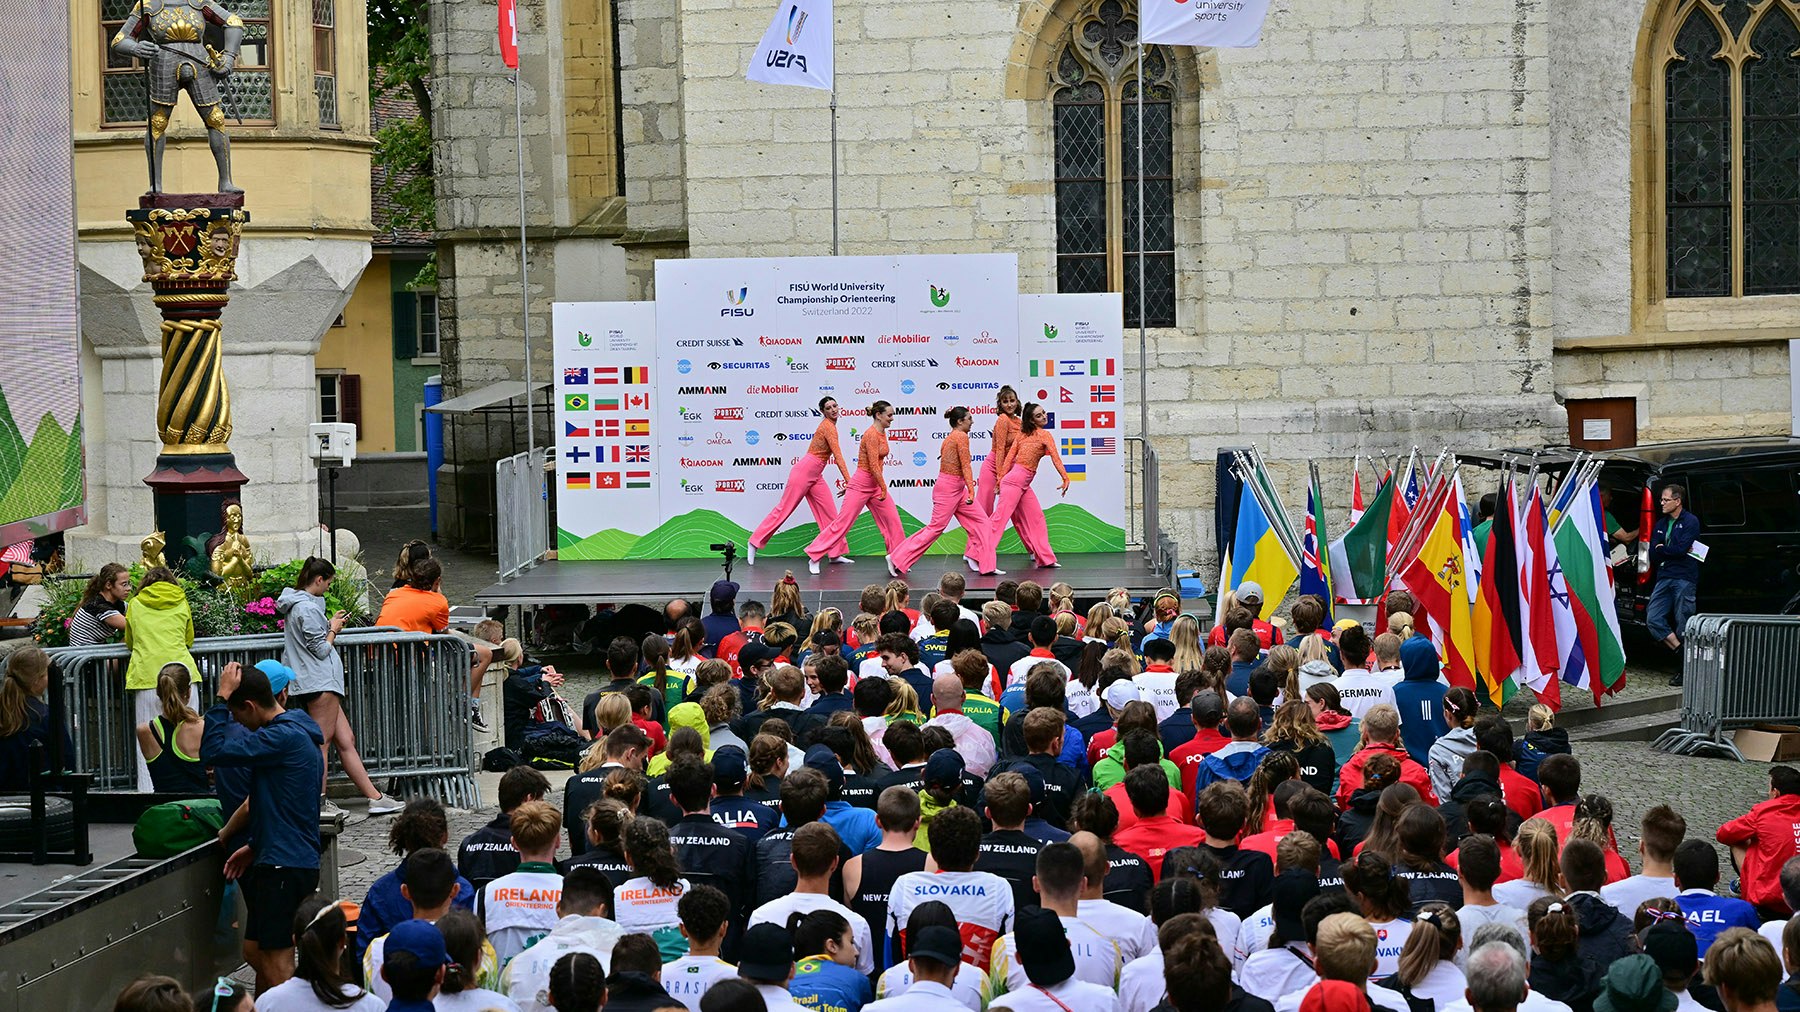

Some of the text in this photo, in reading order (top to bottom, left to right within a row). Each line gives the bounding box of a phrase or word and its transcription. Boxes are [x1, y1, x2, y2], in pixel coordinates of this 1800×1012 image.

[1194, 12, 1227, 22] sports
[789, 282, 885, 292] FISU World University
[777, 294, 896, 305] Championship Orienteering
[721, 308, 754, 317] FISU
[802, 307, 873, 316] Switzerland 2022
[676, 339, 731, 347] CREDIT SUISSE
[766, 337, 802, 346] QIAODAN
[815, 335, 865, 344] AMMANN
[877, 334, 931, 344] die Mobiliar
[722, 362, 770, 370] SECURITAS
[790, 362, 809, 371] EGK
[871, 360, 926, 368] CREDIT SUISSE
[962, 359, 999, 367] QIAODAN
[678, 386, 727, 395] AMMANN
[746, 384, 799, 395] die Mobiliar
[951, 382, 1000, 390] SECURITAS
[754, 410, 809, 419] CREDIT SUISSE
[894, 406, 936, 415] MMANN
[683, 413, 702, 421] EGK
[686, 459, 724, 467] QIAODAN
[732, 457, 782, 466] AMMANN
[684, 484, 704, 493] EGK
[756, 483, 784, 491] CREDIT
[1338, 688, 1382, 698] GERMANY
[712, 810, 758, 824] ALIA
[686, 836, 730, 846] ZEALAND
[466, 842, 519, 852] NEW ZEALAN
[993, 844, 1038, 854] ZEALAND
[1109, 859, 1140, 868] ALAND
[1416, 872, 1459, 880] ZEALAND
[914, 884, 986, 897] SLOVAKIA
[666, 981, 707, 994] BRASI
